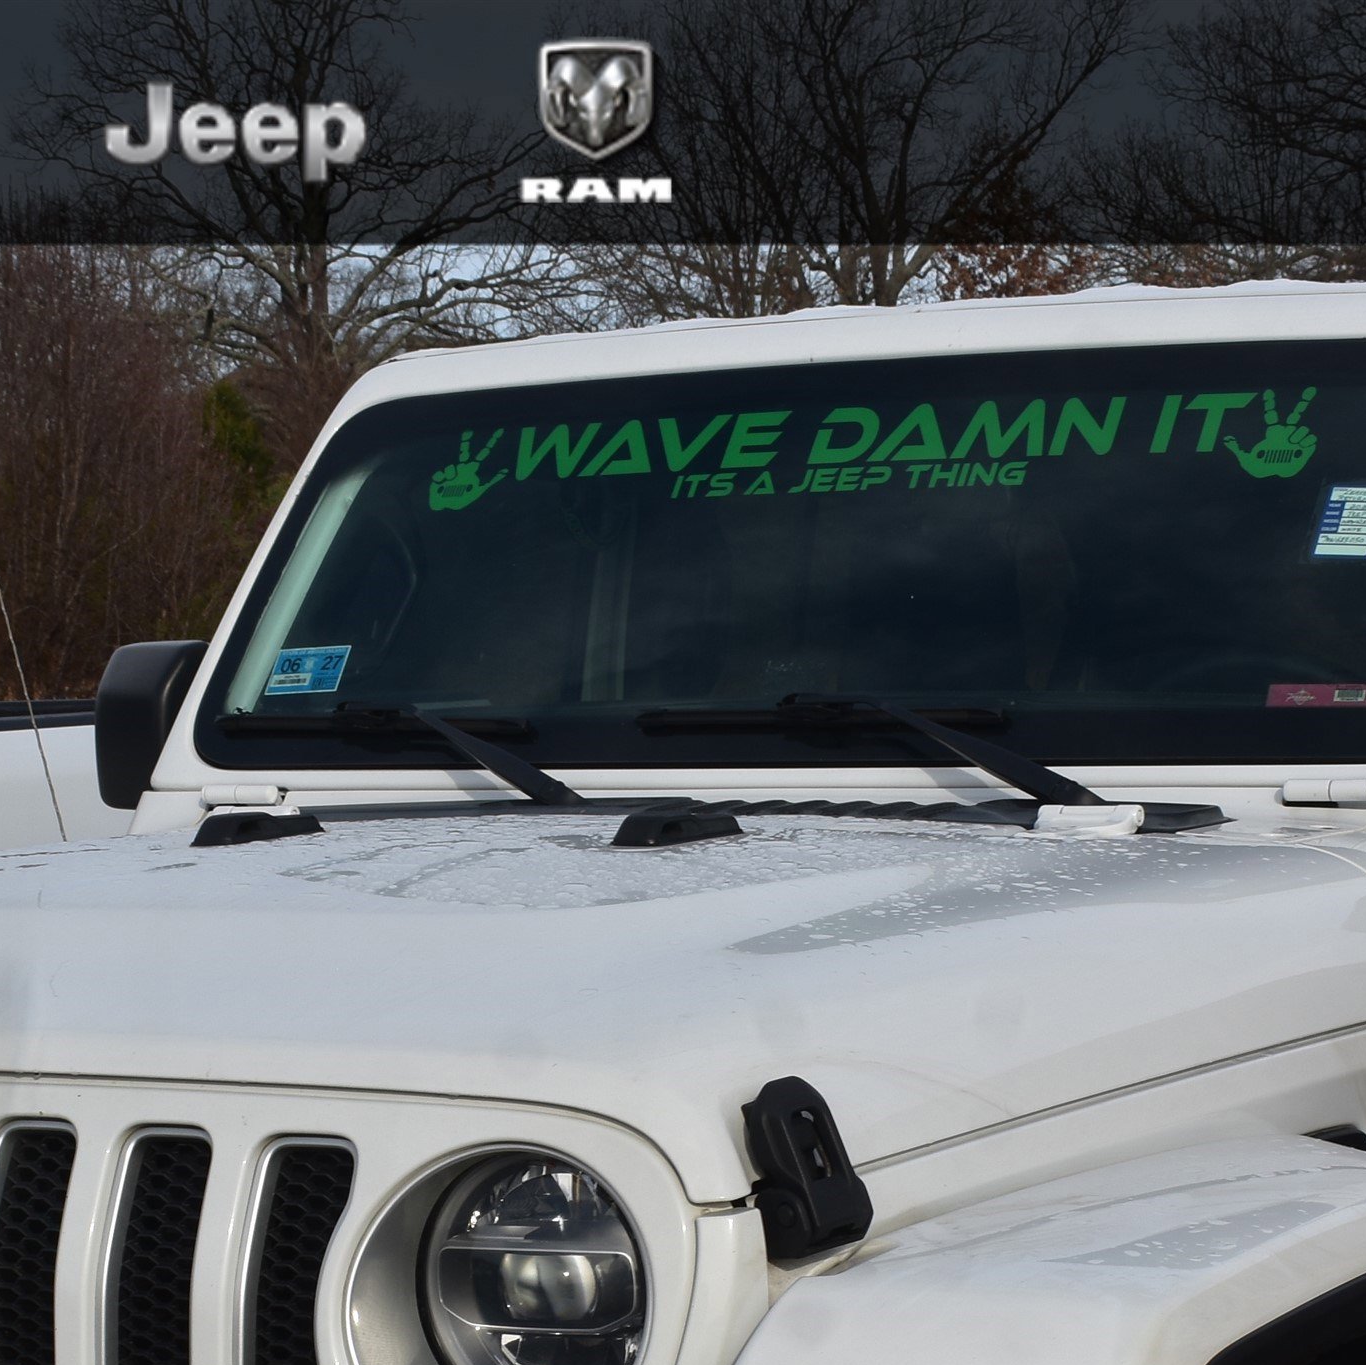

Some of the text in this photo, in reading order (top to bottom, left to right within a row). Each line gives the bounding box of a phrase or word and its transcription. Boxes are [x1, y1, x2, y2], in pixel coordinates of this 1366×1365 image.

[516, 393, 1255, 480] WAVE DAMN IT
[672, 462, 1027, 499] ITS A JEEP THING
[280, 654, 344, 674] 06 27
